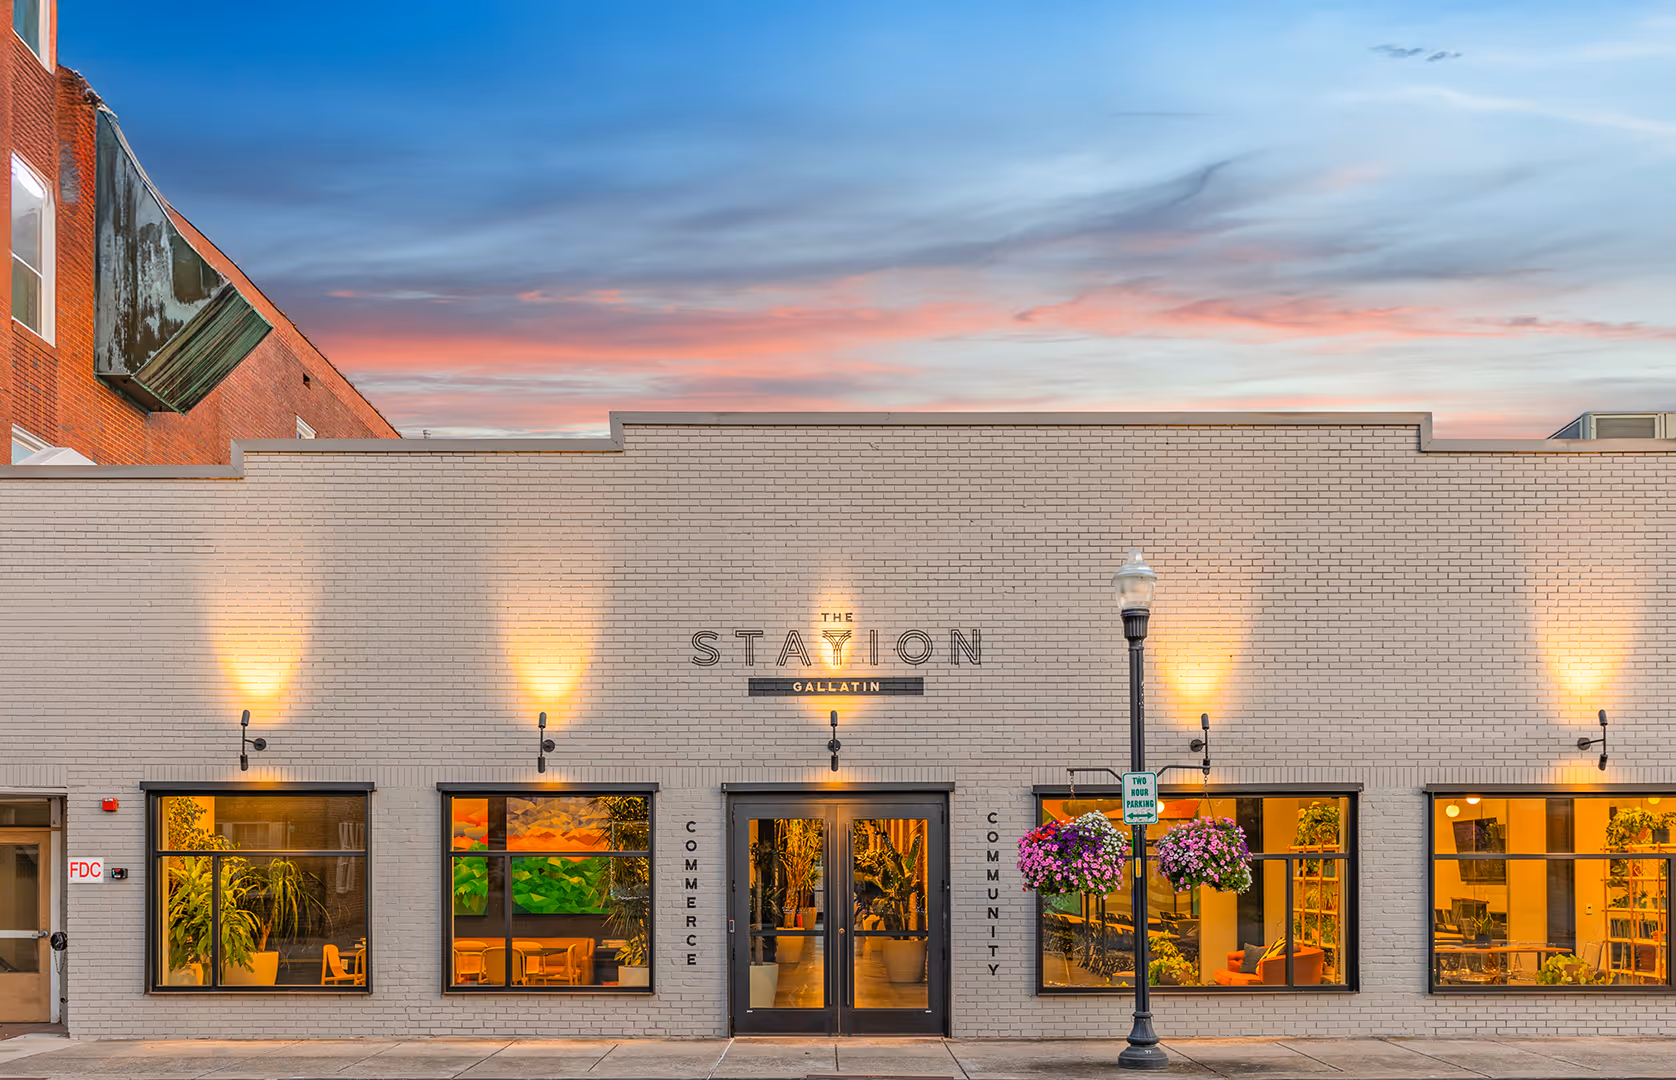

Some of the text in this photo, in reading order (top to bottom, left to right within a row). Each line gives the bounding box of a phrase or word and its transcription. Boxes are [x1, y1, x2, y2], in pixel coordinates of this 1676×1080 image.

[821, 612, 853, 622] THE
[691, 629, 981, 667] STATION
[792, 681, 880, 692] GALLATIN
[1132, 777, 1147, 785] TWO
[1131, 788, 1149, 797] HOUR
[1126, 800, 1154, 808] PARKING
[70, 861, 102, 878] FDC
[685, 821, 698, 965] COMMERCE
[986, 812, 999, 976] COMMUNITY
